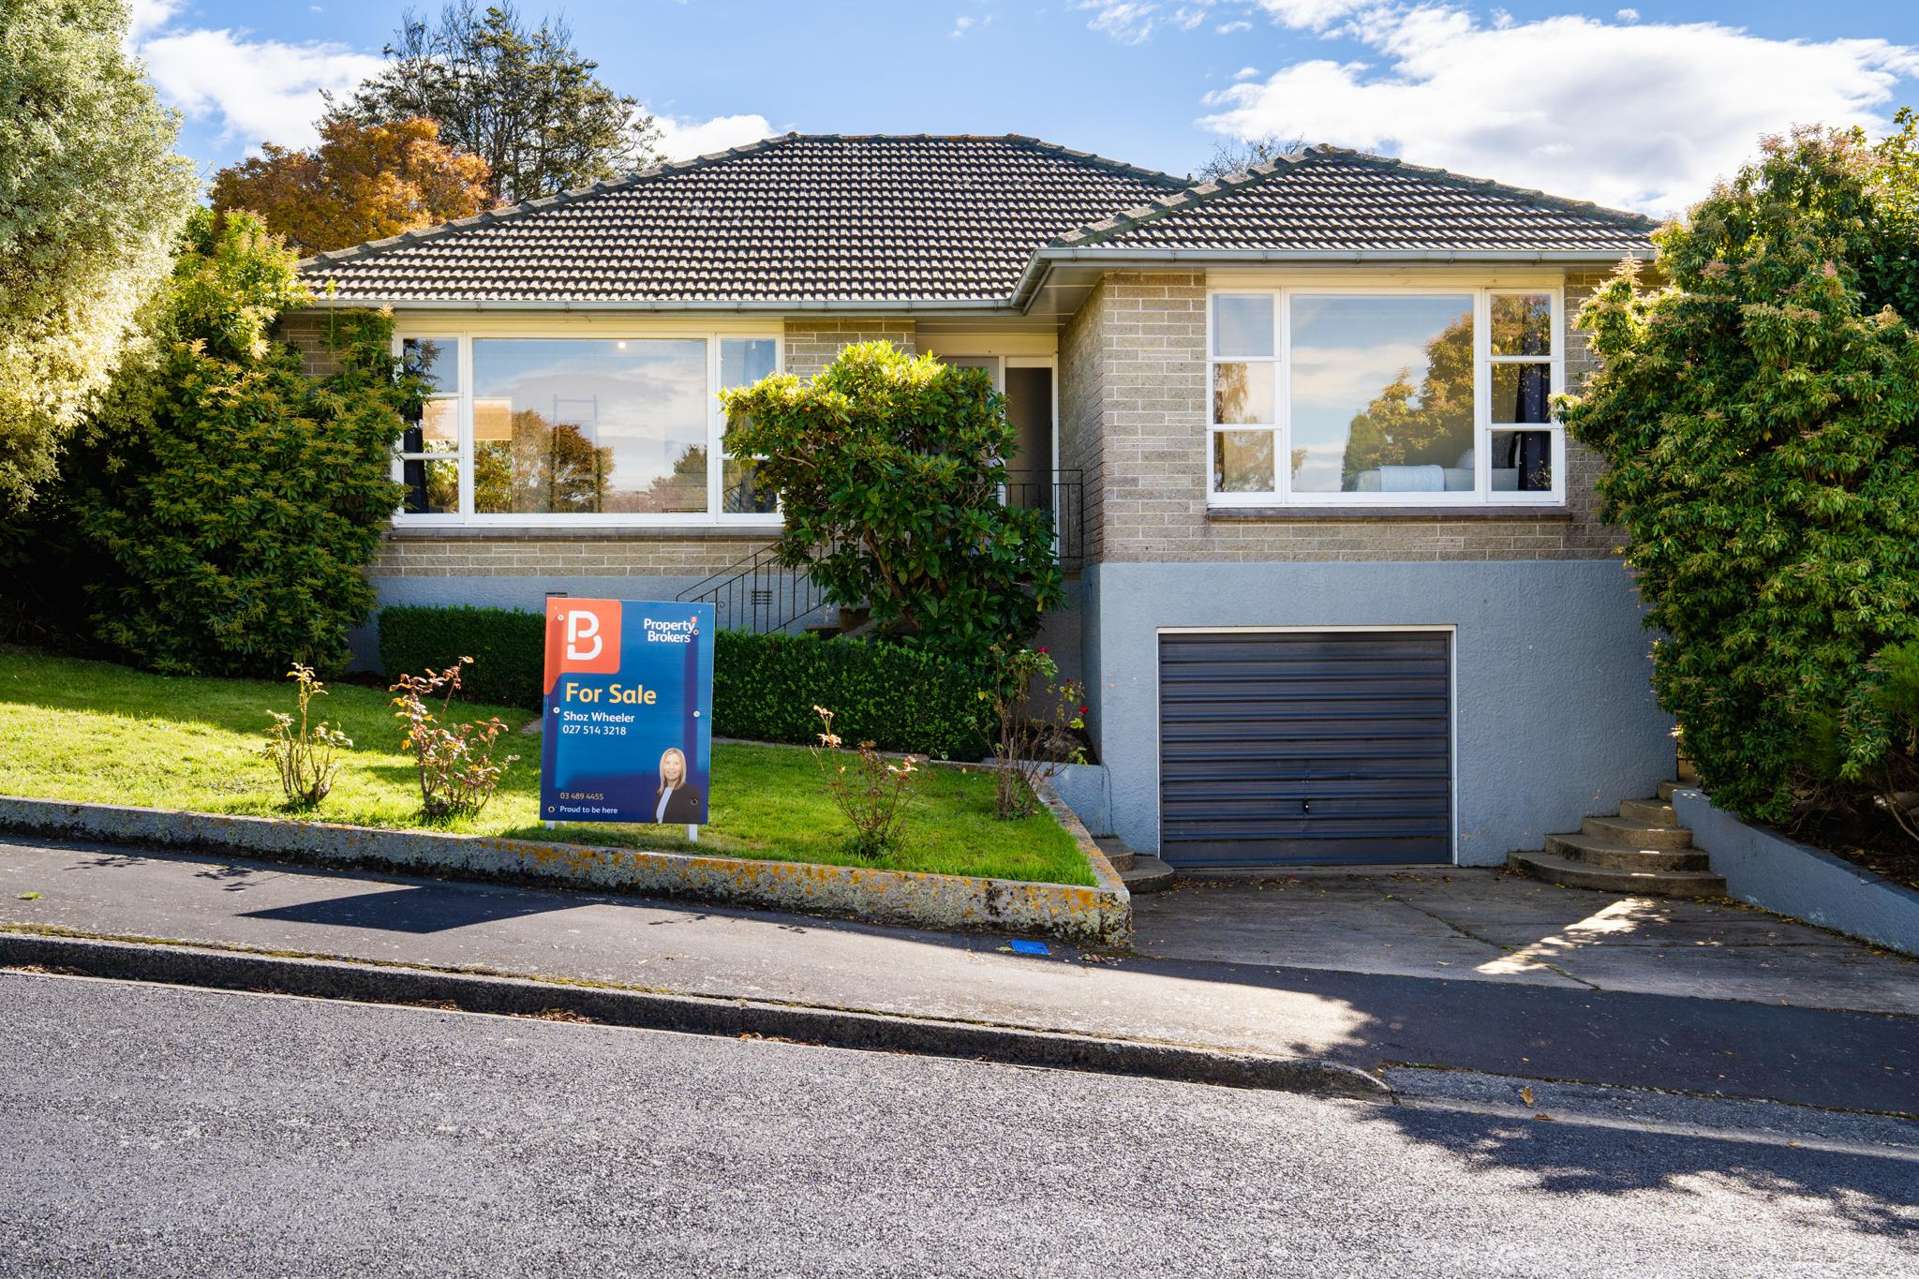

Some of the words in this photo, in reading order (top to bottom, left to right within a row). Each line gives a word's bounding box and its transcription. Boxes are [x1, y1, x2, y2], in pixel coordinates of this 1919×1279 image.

[644, 618, 696, 634] Property
[647, 631, 691, 643] Brokers
[566, 683, 602, 702] For
[609, 684, 657, 704] Sale
[563, 711, 588, 722] Shoz
[592, 712, 634, 723] Wheeler
[563, 725, 580, 734] 027
[583, 726, 601, 735] 514
[603, 726, 626, 736] 3218
[560, 792, 570, 800] 03
